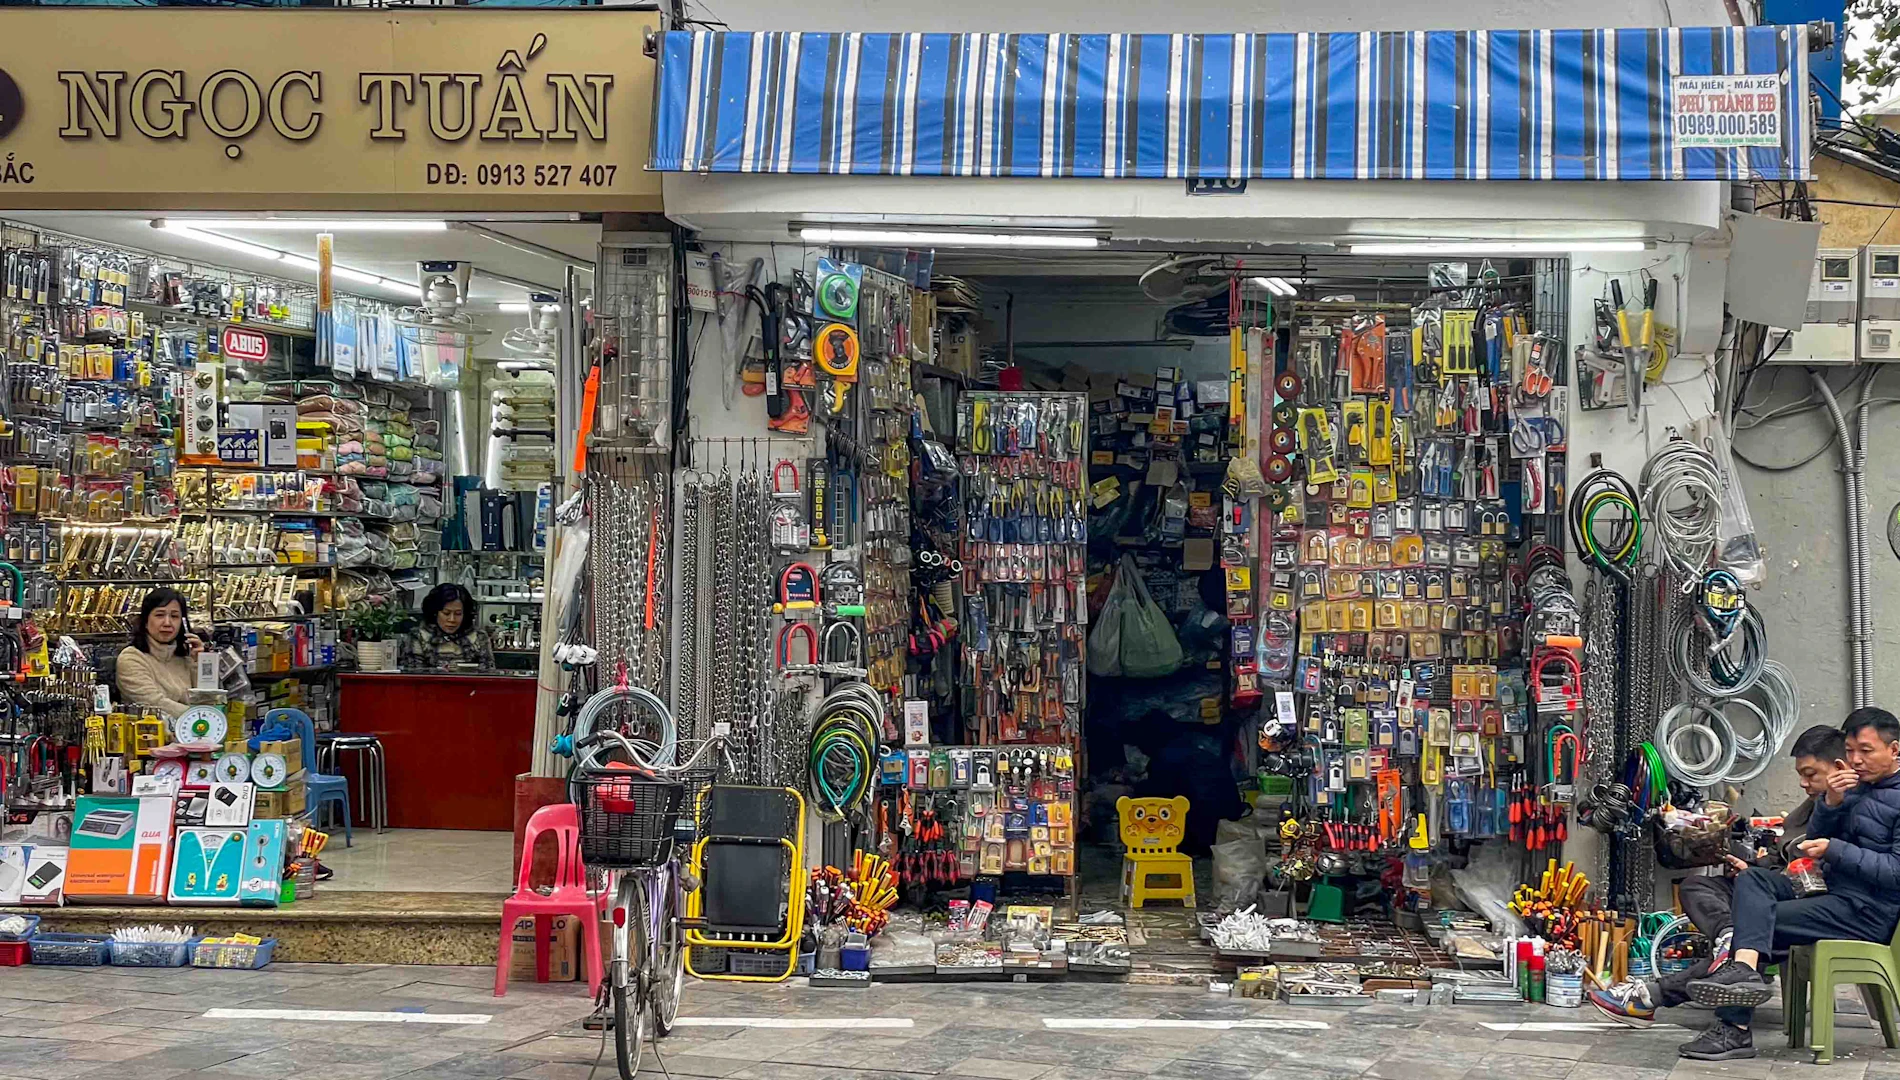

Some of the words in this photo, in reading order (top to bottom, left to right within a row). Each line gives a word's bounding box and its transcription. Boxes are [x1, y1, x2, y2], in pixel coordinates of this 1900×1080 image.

[1679, 80, 1698, 90] MÁI
[1701, 80, 1725, 89] HIÊN
[1734, 79, 1754, 89] MÁI
[1756, 76, 1776, 89] XẾP
[57, 69, 321, 160] NGỌC
[359, 32, 615, 142] TUẤN
[1678, 90, 1705, 113] PHÚ
[1708, 89, 1755, 113] THÀNH
[1678, 113, 1777, 136] 0989.000.589
[0, 152, 35, 184] ẮC
[427, 163, 467, 186] DĐ:
[477, 164, 526, 187] 0913
[534, 165, 573, 188] 527
[579, 165, 618, 188] 407
[229, 333, 263, 354] ABUS
[186, 403, 194, 421] VIỆT
